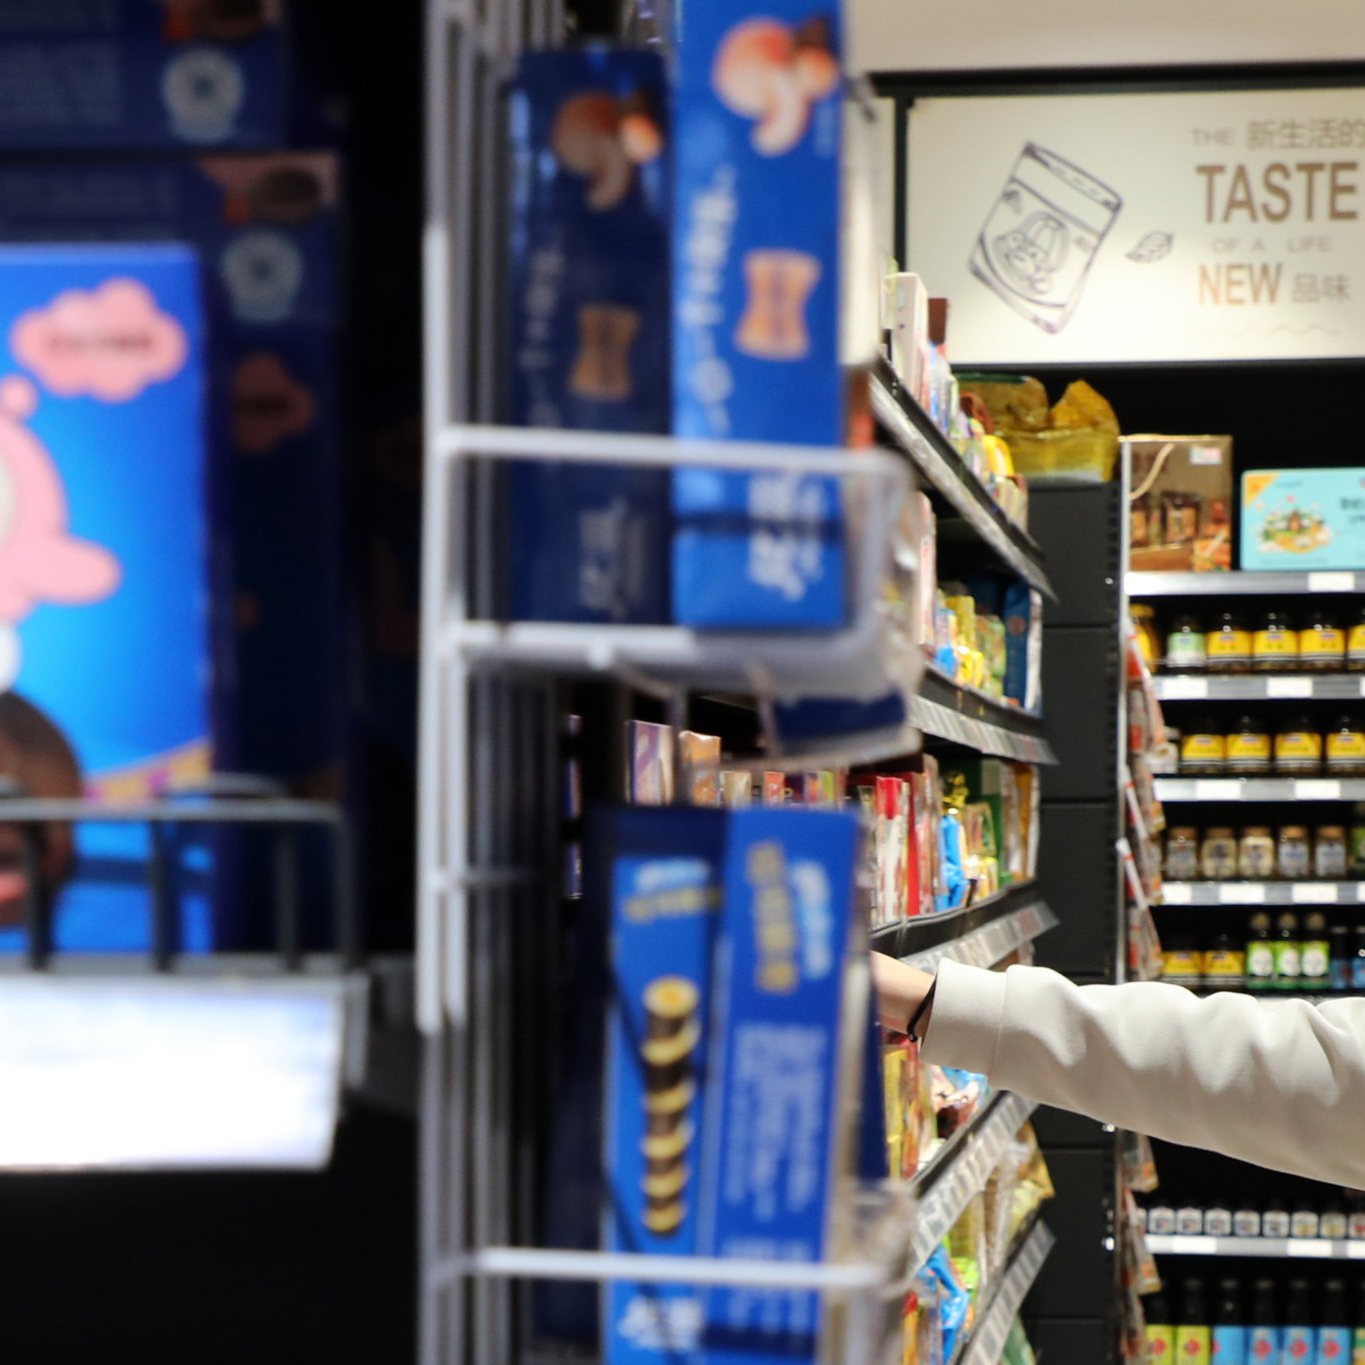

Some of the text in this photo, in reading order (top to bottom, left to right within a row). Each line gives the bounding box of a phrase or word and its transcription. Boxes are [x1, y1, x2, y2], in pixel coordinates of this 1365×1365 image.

[1191, 127, 1232, 146] THE
[1195, 161, 1359, 224] TASTE
[1198, 261, 1352, 305] NEW 品味
